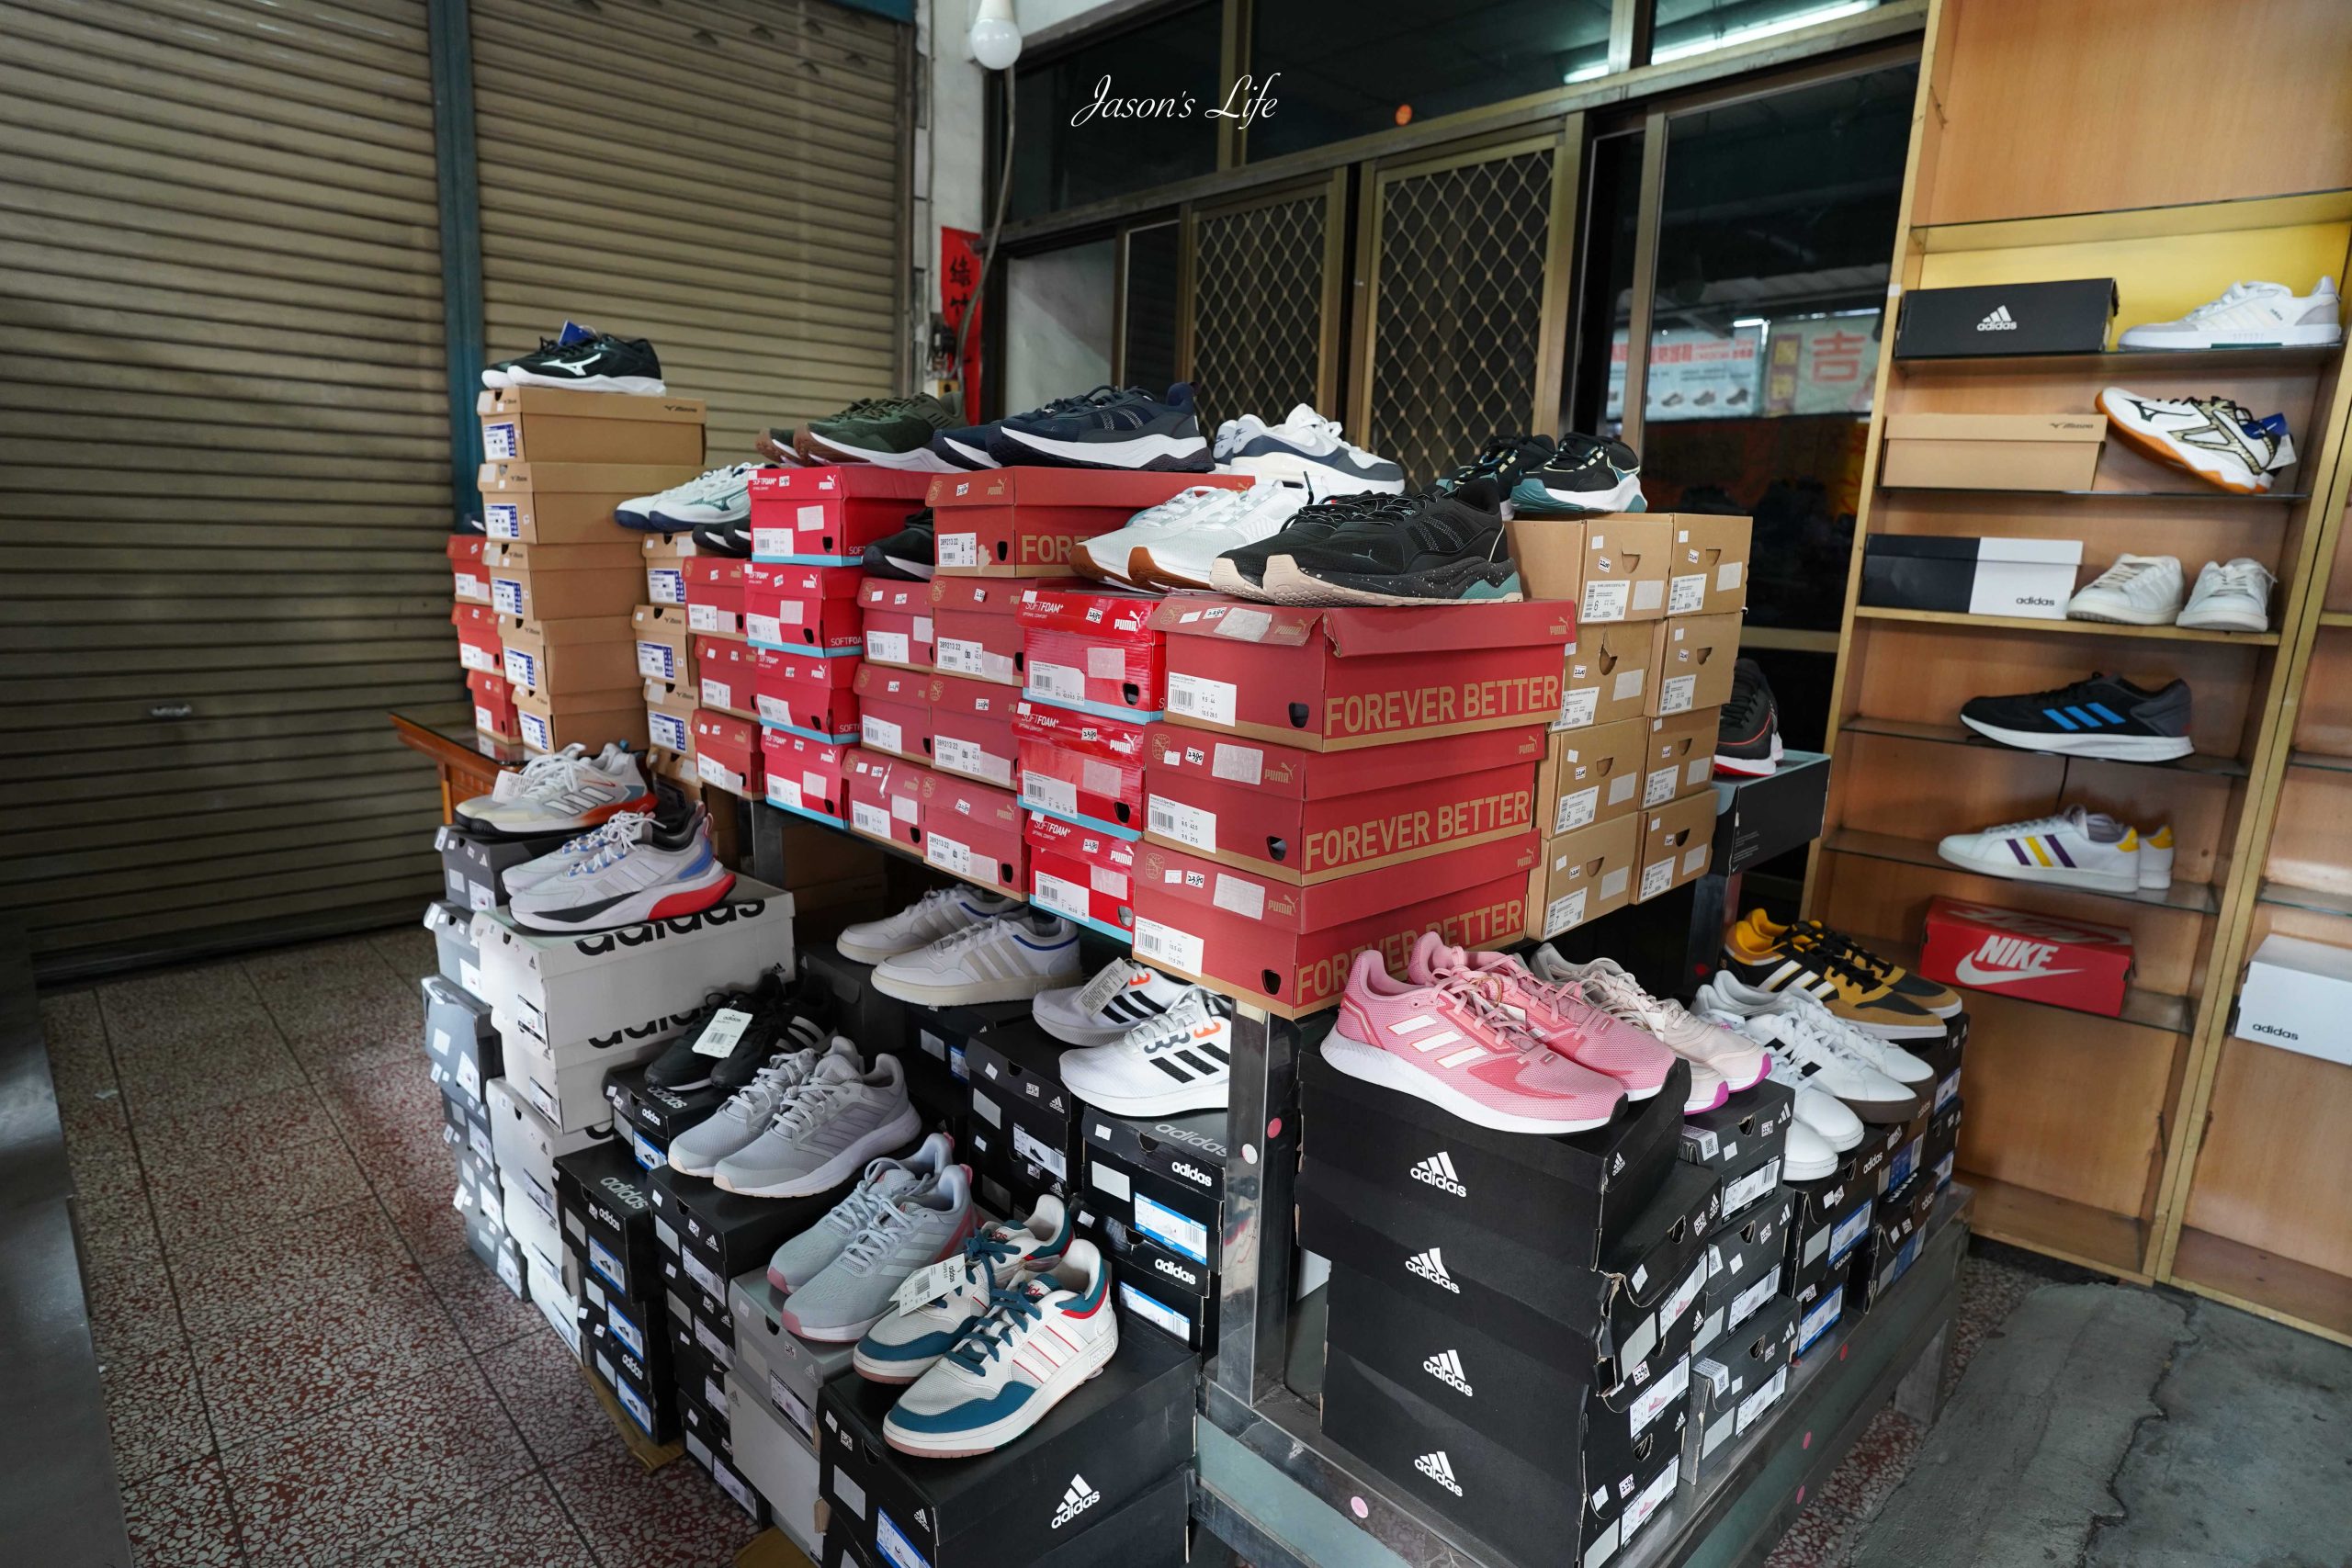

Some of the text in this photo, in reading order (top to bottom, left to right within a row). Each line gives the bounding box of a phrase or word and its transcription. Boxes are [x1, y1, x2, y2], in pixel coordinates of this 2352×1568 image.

[1976, 319, 2017, 332] adidas
[2016, 595, 2055, 607] adidas
[1114, 618, 1138, 632] PUMA
[1273, 625, 1301, 636] PUMA
[939, 640, 961, 651] 389213 22
[1326, 675, 1559, 735] FOREVER BETTER
[936, 738, 958, 750] 389213 22
[1109, 739, 1133, 754] PUMA
[1519, 743, 1536, 755] PUMA
[1187, 751, 1203, 762] 2380
[1264, 768, 1290, 784] PUMA
[1305, 790, 1530, 871] FOREVER BETTER
[929, 835, 950, 850] 389213 22
[1110, 850, 1133, 866] PUMA
[1187, 874, 1204, 886] 2380
[1268, 899, 1294, 916] PUMA
[1975, 935, 2059, 971] NIKE
[2252, 1022, 2300, 1041] adidas
[642, 1108, 661, 1126] adidas
[1155, 1123, 1227, 1157] adidas
[1863, 1151, 1883, 1175] adidas
[1171, 1161, 1212, 1187] adidas
[1409, 1166, 1467, 1198] adidas
[600, 1177, 649, 1210] adidas
[599, 1208, 620, 1232] adidas
[1154, 1258, 1196, 1285] adidas
[1405, 1258, 1461, 1295] adidas
[622, 1353, 643, 1381] adidas
[1423, 1361, 1473, 1397] adidas
[1414, 1461, 1463, 1497] adidas
[1051, 1489, 1101, 1530] adidas
